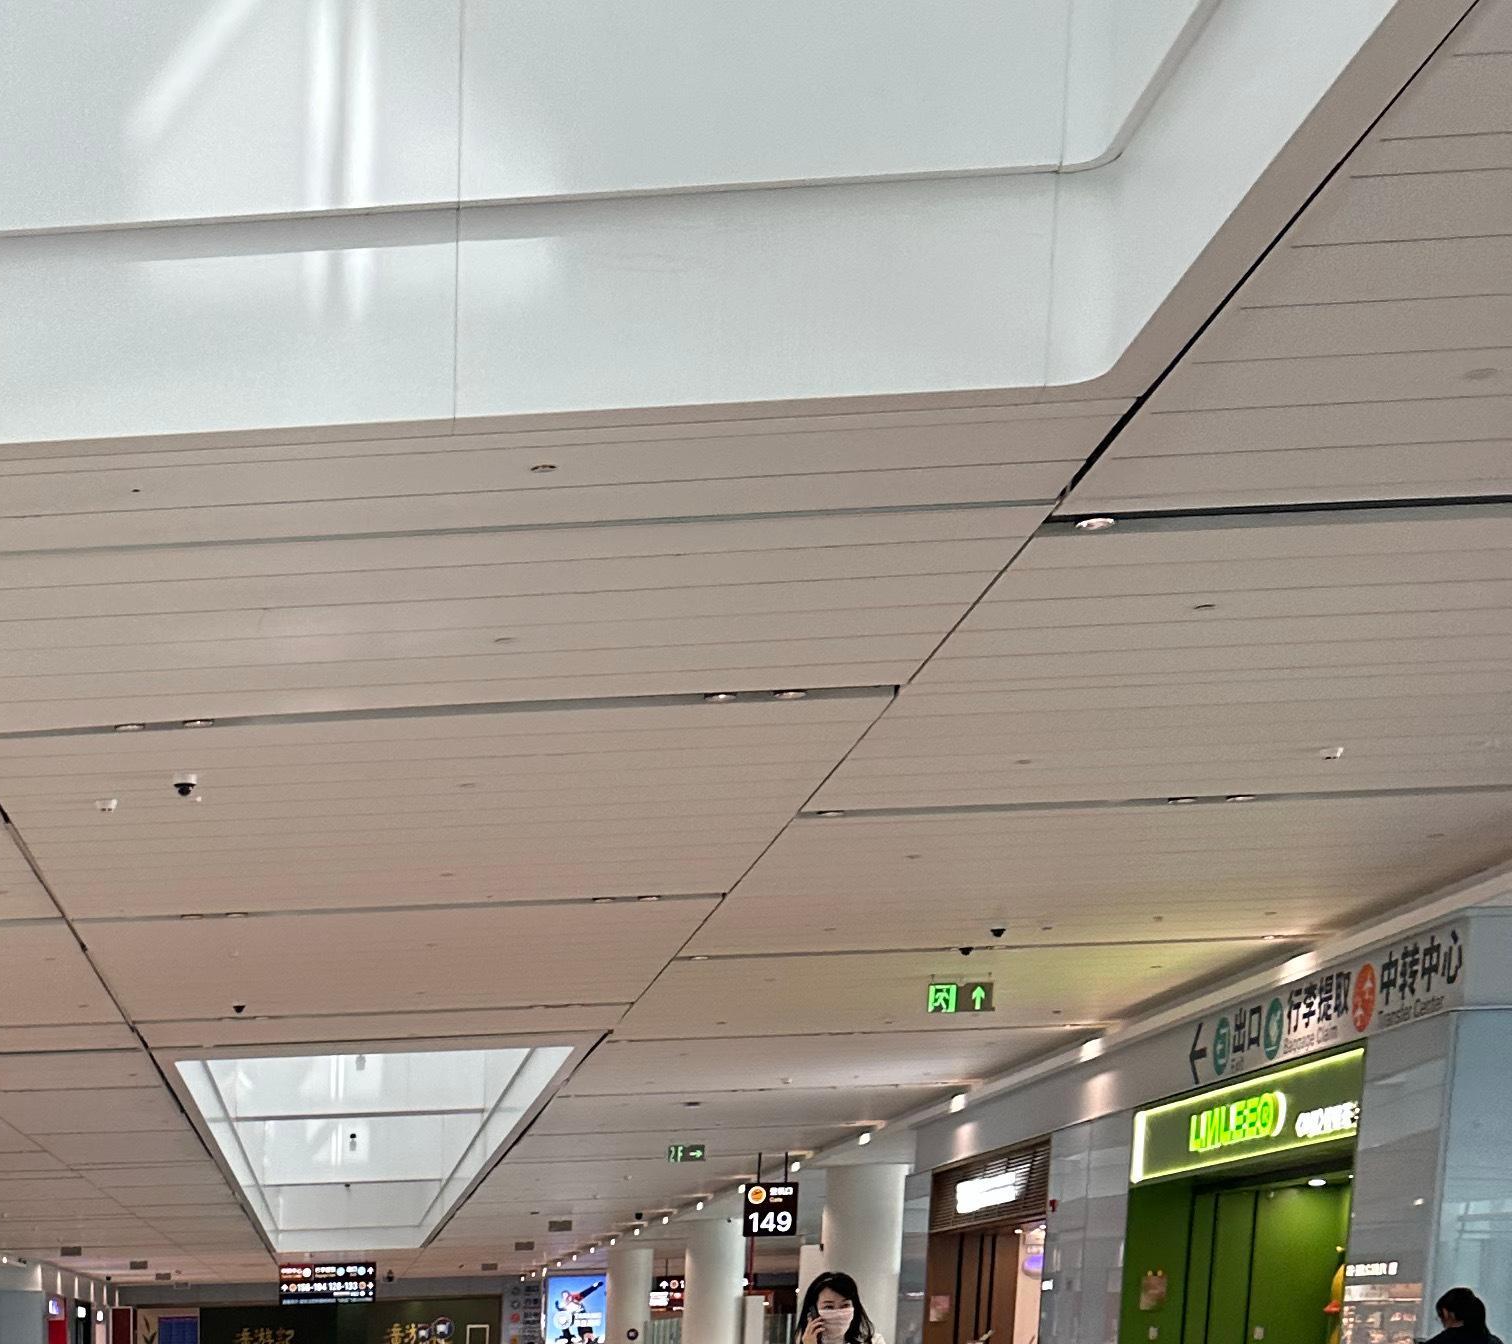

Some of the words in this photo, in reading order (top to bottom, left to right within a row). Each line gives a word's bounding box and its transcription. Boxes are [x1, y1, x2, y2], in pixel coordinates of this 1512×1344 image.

[1232, 1005, 1262, 1053] 出口
[1287, 971, 1352, 1034] 行李提取
[1379, 930, 1463, 1006] 中转中心
[748, 1211, 793, 1233] 149
